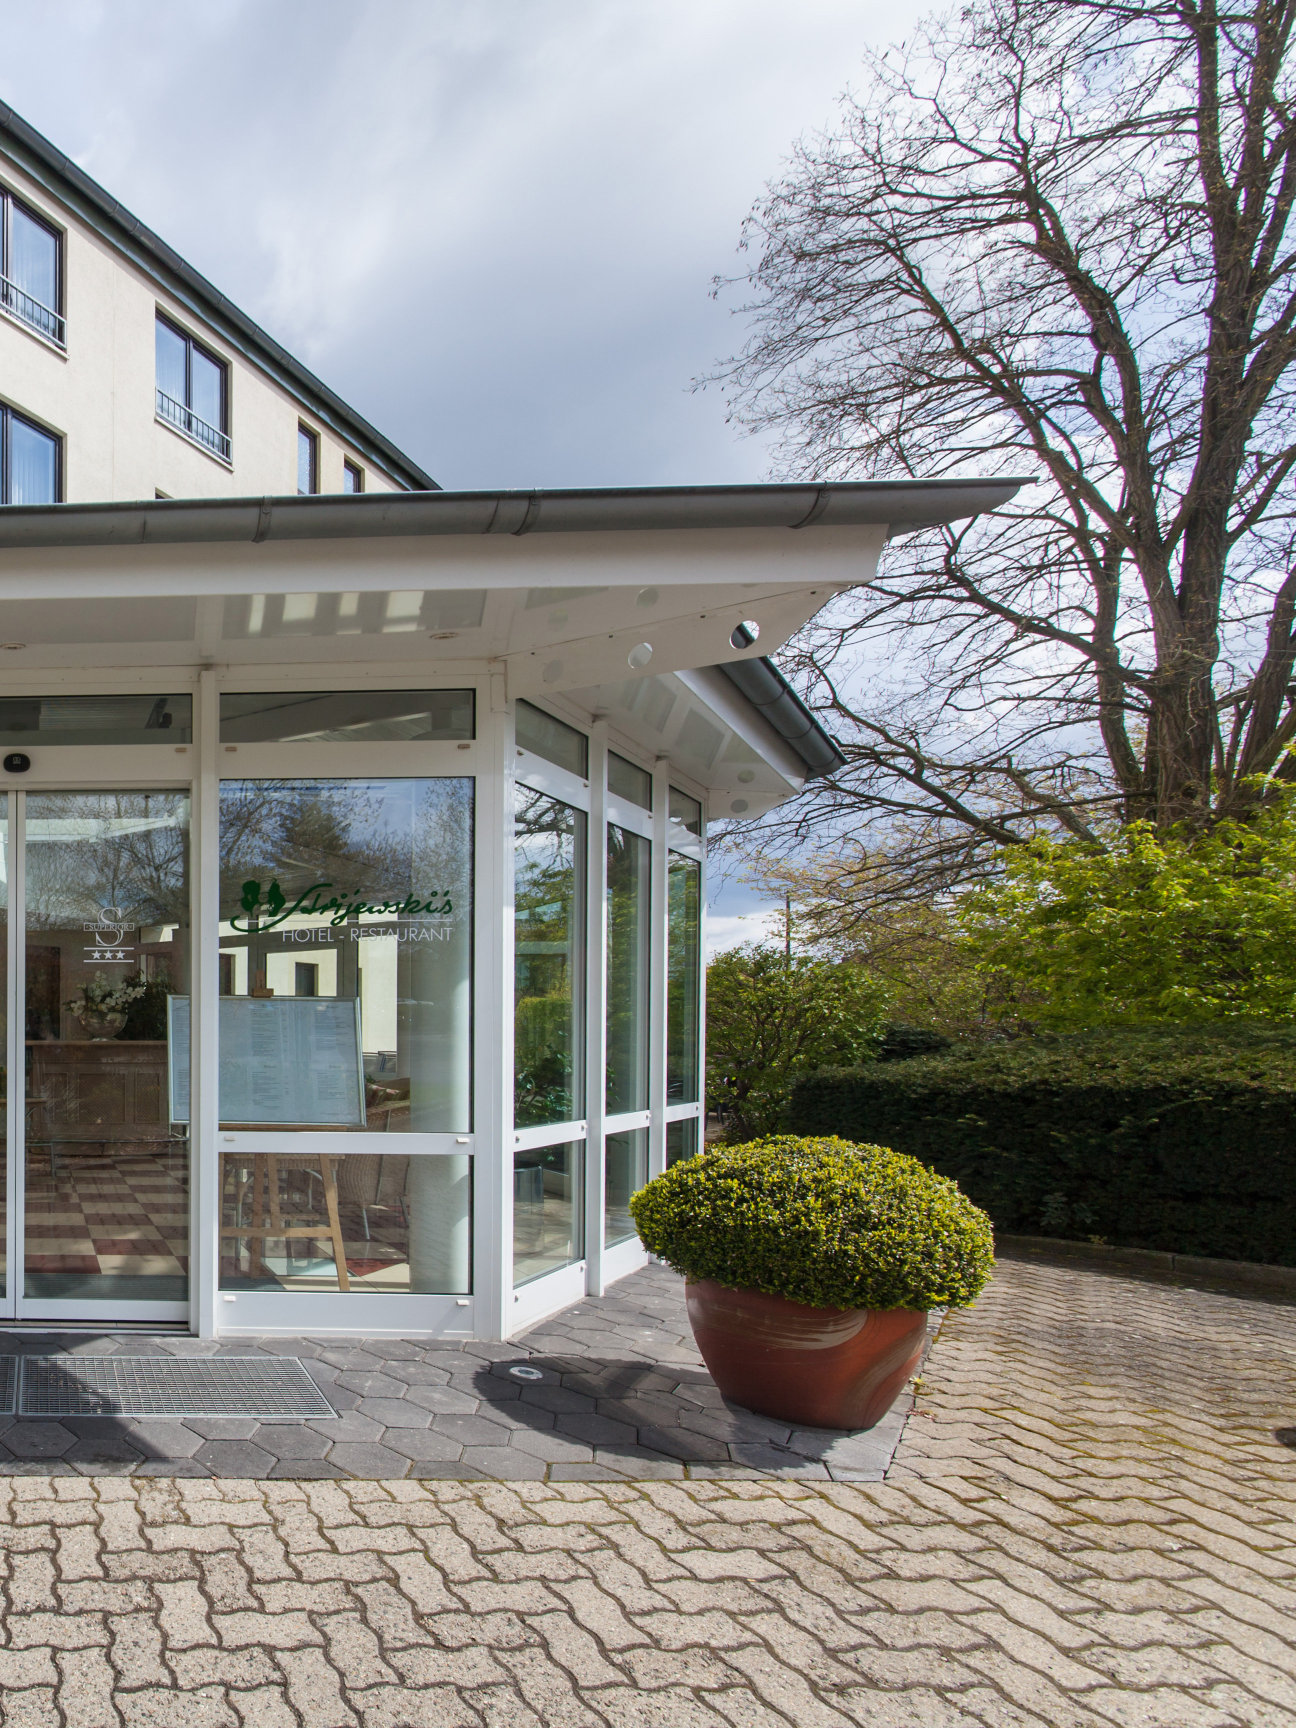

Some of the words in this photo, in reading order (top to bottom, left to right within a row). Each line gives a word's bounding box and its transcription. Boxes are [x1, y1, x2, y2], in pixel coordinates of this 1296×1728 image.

[89, 923, 129, 931] SUPERIOR
[283, 928, 334, 942] HOTEL
[351, 927, 453, 942] RESTAURANT
